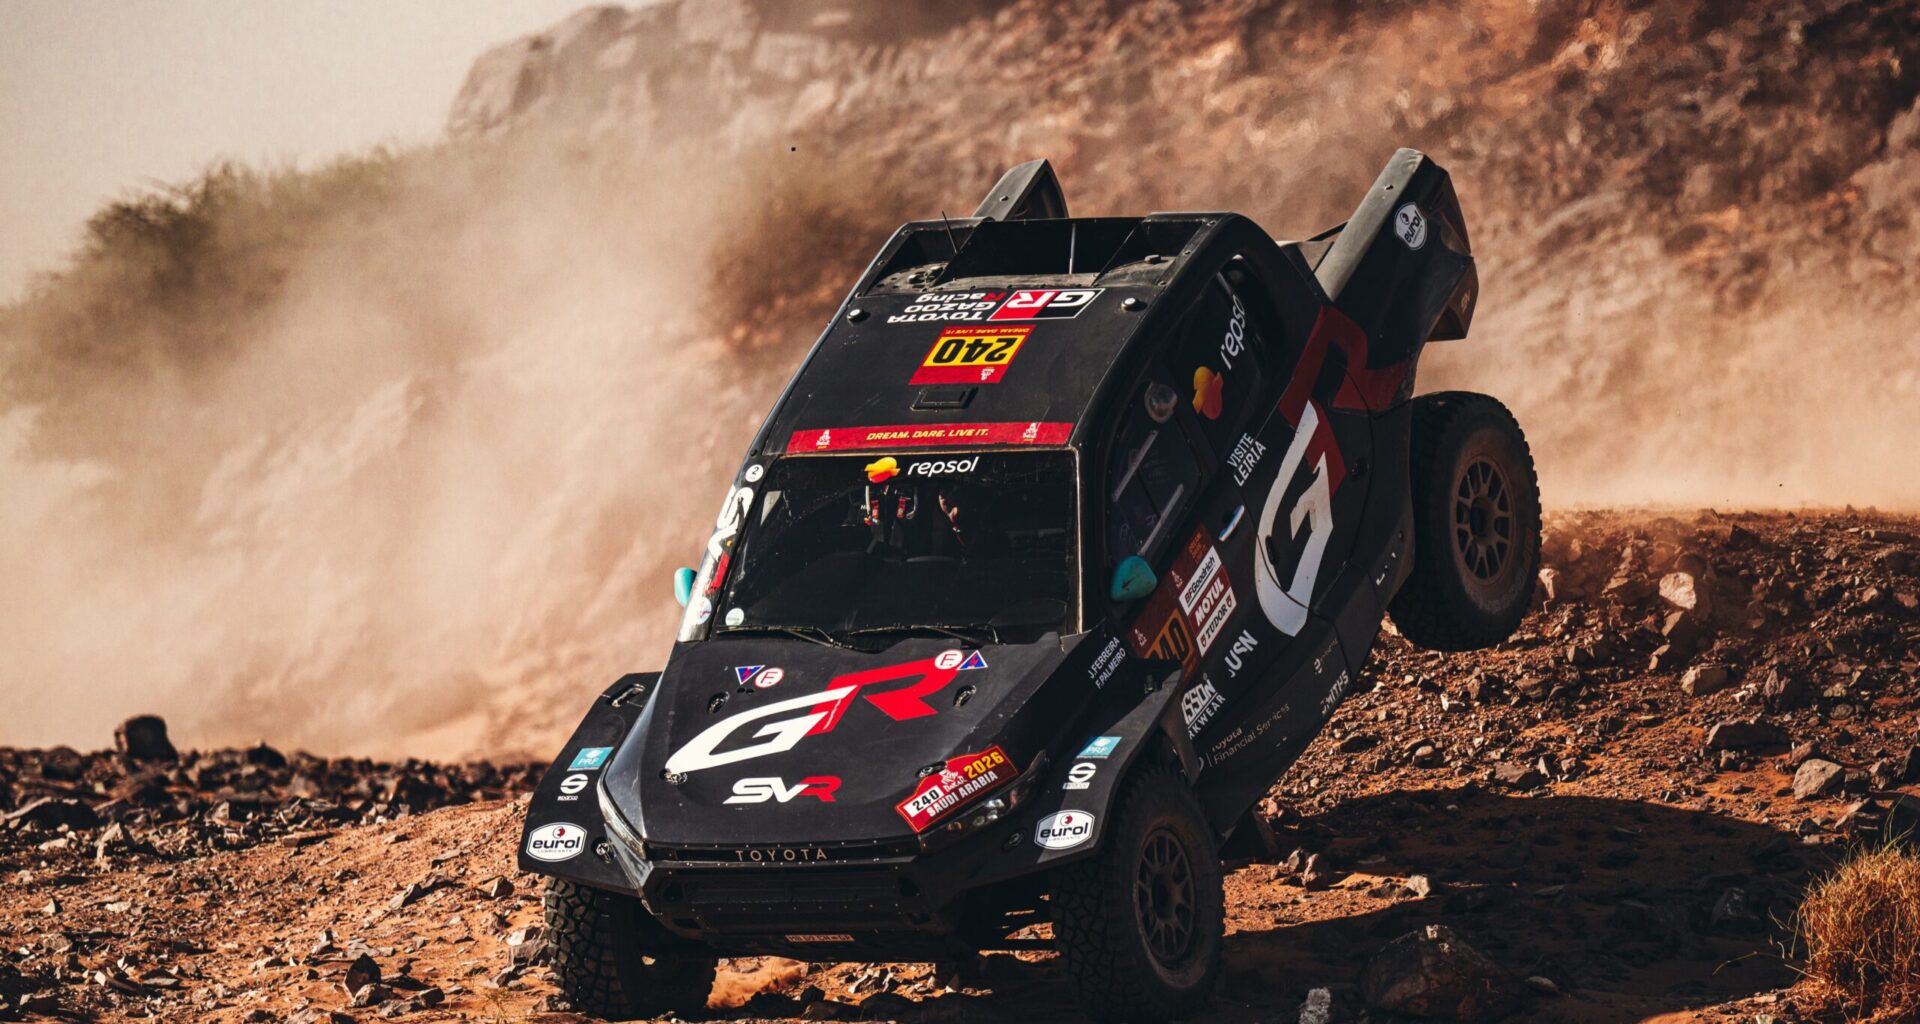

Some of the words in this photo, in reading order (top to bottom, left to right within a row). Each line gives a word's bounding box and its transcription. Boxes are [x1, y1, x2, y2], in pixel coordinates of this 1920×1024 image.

[1404, 210, 1422, 243] eurol
[904, 301, 997, 313] GAZOO
[915, 292, 1006, 303] Racing
[1006, 290, 1096, 308] GR
[887, 311, 983, 323] TOYOTA
[1220, 294, 1246, 370] repso
[932, 337, 1018, 364] 240
[866, 432, 910, 441] DREAM.
[912, 430, 946, 439] DARE.
[948, 429, 975, 437] LIVE
[975, 428, 989, 436] IT.
[1227, 432, 1254, 468] VISITE
[907, 456, 979, 477] repsol
[1234, 440, 1266, 487] LEIRIA
[1255, 304, 1410, 637] GR
[1184, 556, 1215, 604] BFGoodrich
[1195, 577, 1224, 627] MOTUL
[1205, 603, 1228, 640] TUDOR
[1088, 636, 1120, 679] J.FERREIRA
[1095, 647, 1126, 689] F.PALMEIRO
[664, 656, 963, 775] GR
[1213, 730, 1256, 765] Financial
[963, 751, 1004, 779] 2026
[722, 776, 842, 805] SVR
[912, 789, 940, 812] 240
[925, 792, 960, 817] SAUDI
[958, 770, 998, 798] ARABIA
[532, 836, 581, 849] eurol
[1040, 822, 1089, 838] eurol
[736, 848, 828, 862] TOYOTA
